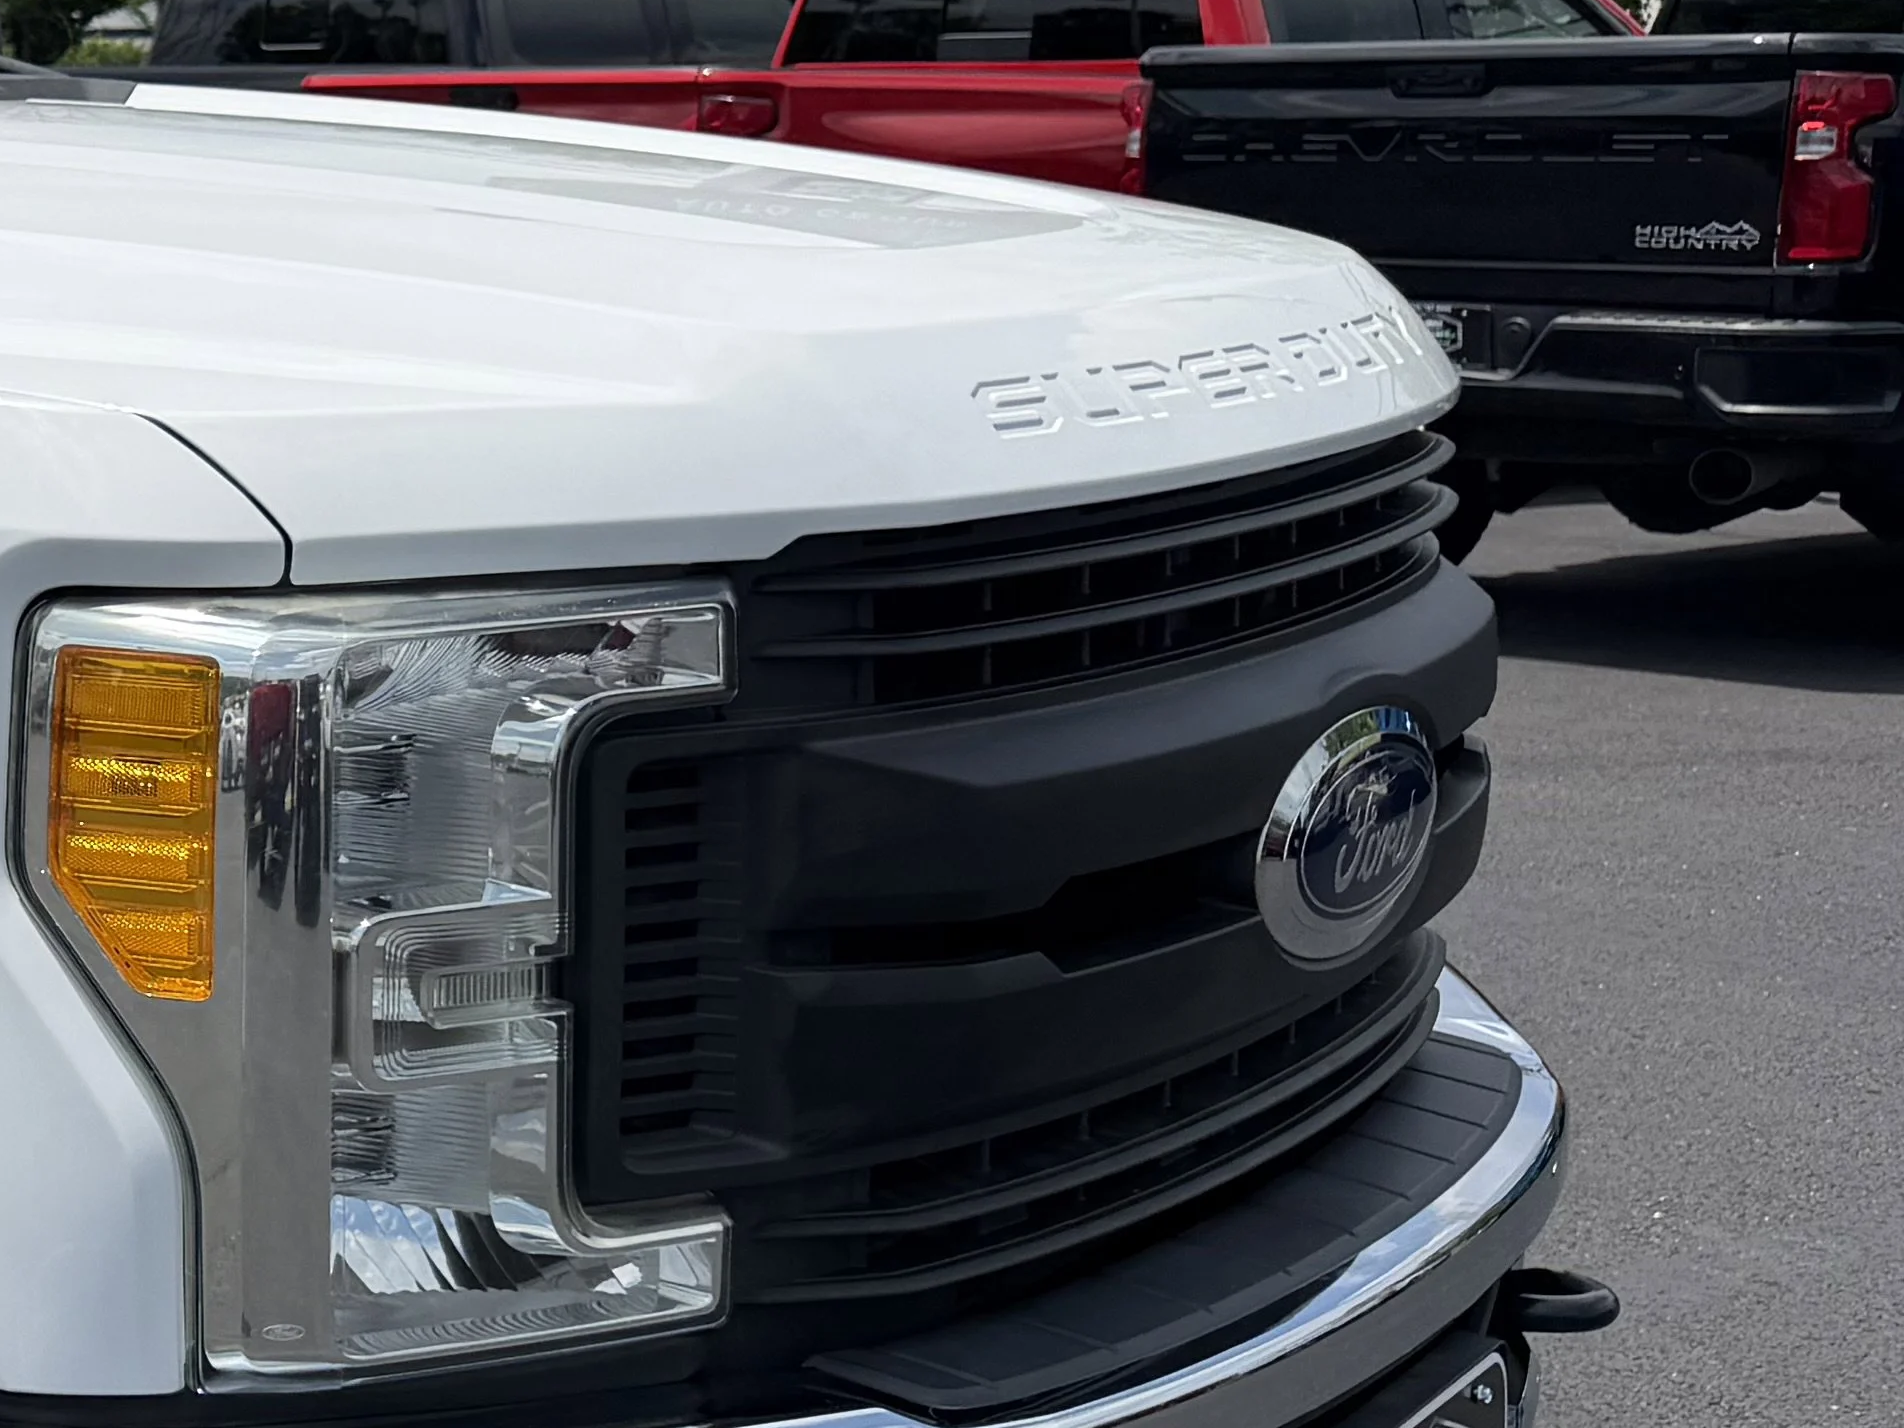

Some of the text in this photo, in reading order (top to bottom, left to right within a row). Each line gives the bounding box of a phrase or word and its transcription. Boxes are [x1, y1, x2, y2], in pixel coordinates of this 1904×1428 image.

[1633, 223, 1698, 237] HIGH
[1633, 236, 1756, 251] COUNTRY
[970, 342, 1303, 440] SUPER
[1334, 789, 1418, 894] Ford
